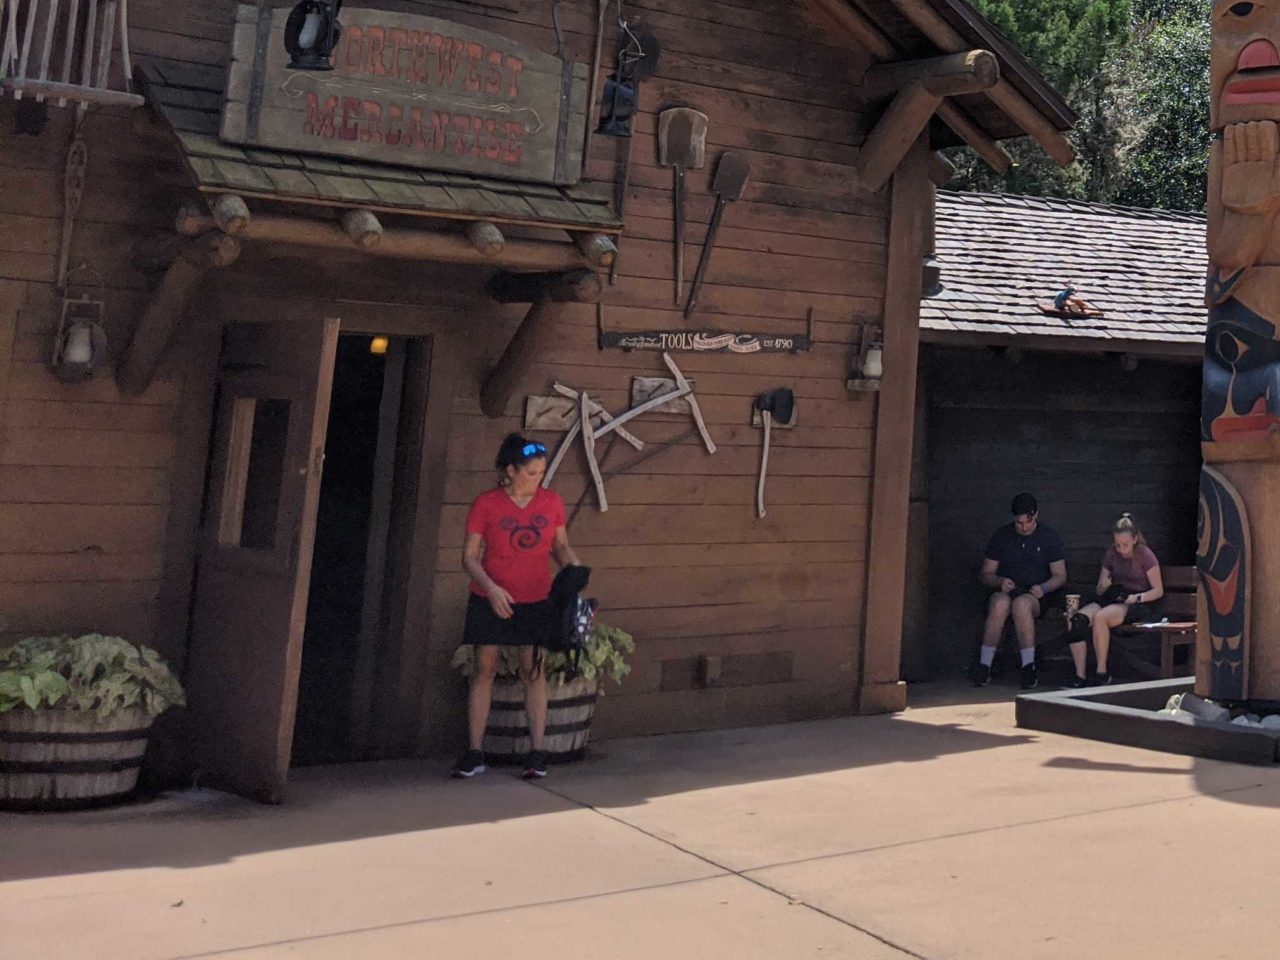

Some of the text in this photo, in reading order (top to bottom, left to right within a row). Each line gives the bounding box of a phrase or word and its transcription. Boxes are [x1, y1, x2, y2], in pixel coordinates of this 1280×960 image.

[331, 25, 525, 98] ORTHWEST
[303, 92, 525, 164] MERCANTILE
[659, 333, 693, 350] TOOLS
